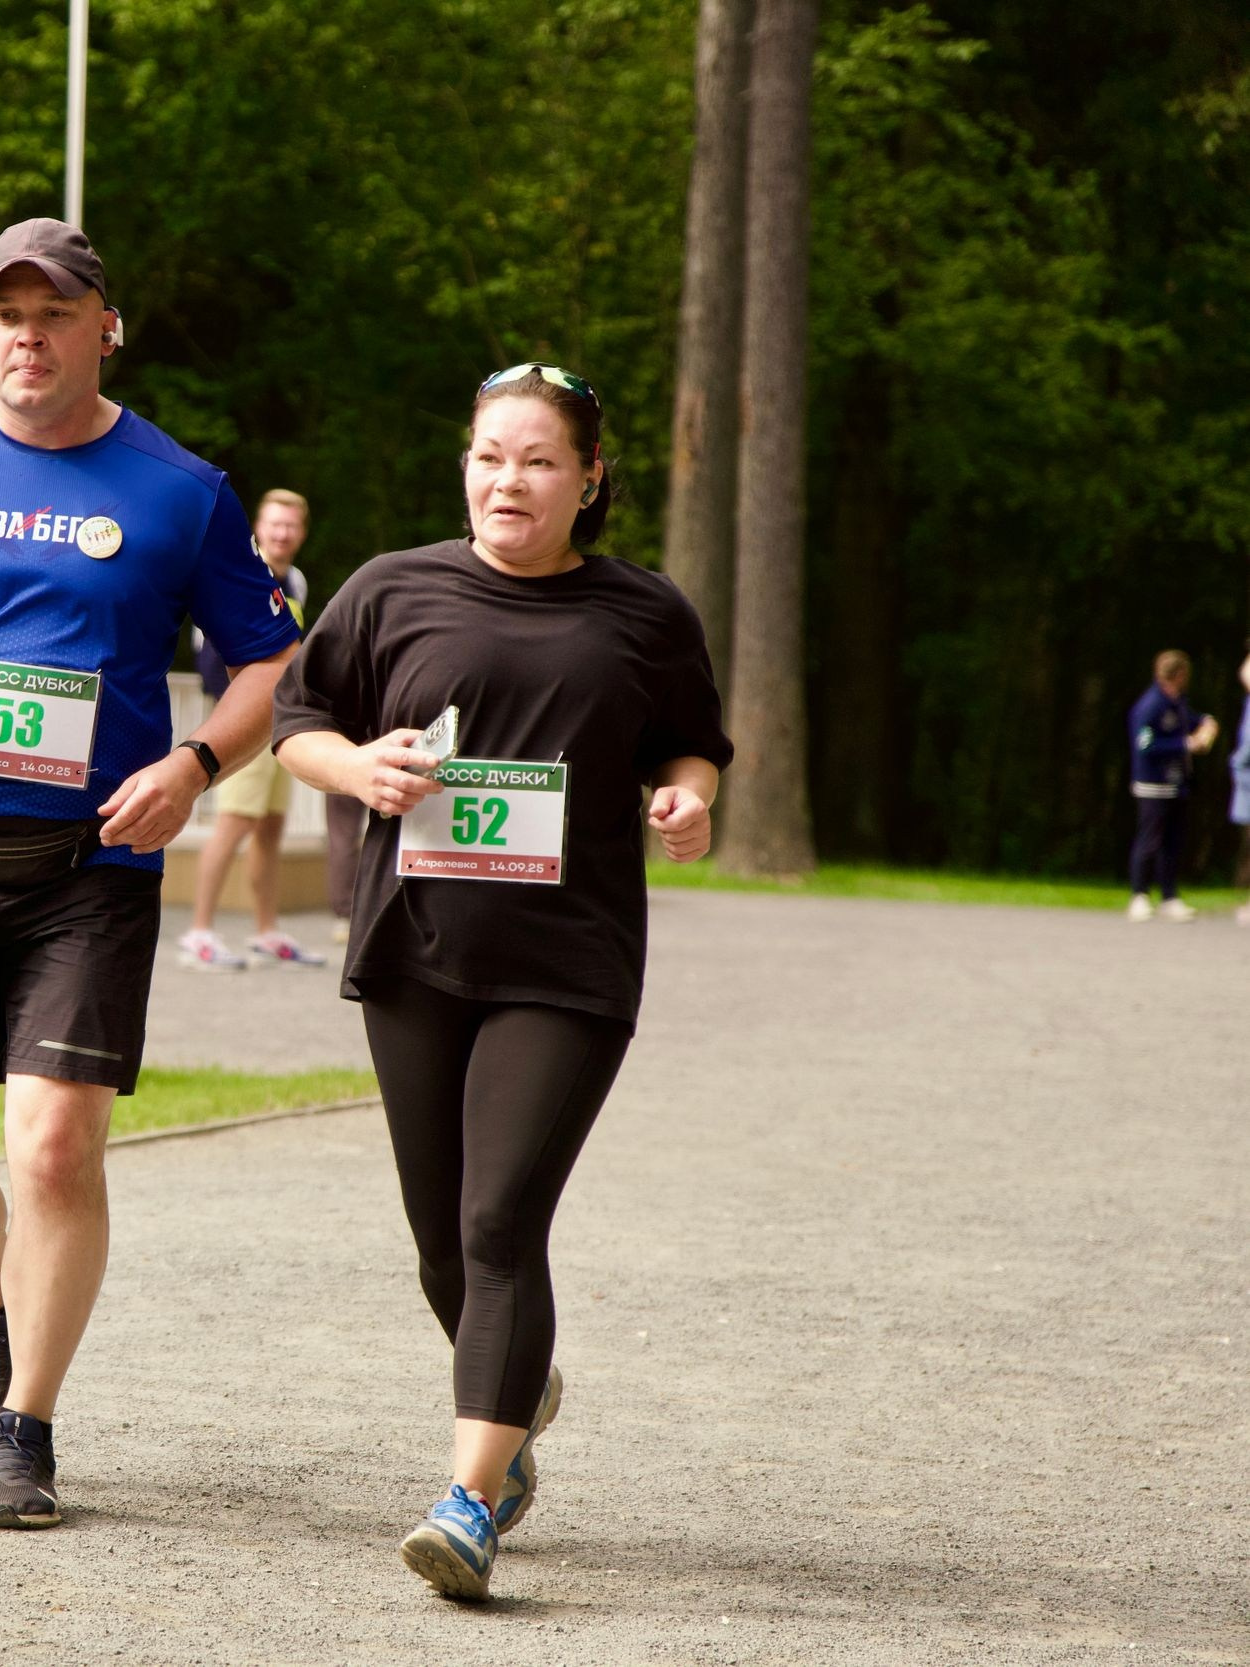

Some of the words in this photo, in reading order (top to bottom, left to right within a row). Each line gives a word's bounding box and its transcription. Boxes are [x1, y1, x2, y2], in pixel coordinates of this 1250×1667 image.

[23, 674, 83, 694] ДУБКИ
[20, 761, 71, 777] 14.09.25
[431, 768, 482, 783] РОСС
[485, 769, 548, 786] ДУБКИ
[451, 796, 510, 846] 52
[415, 858, 478, 870] Апрелевка
[489, 861, 544, 874] 14.09.25
